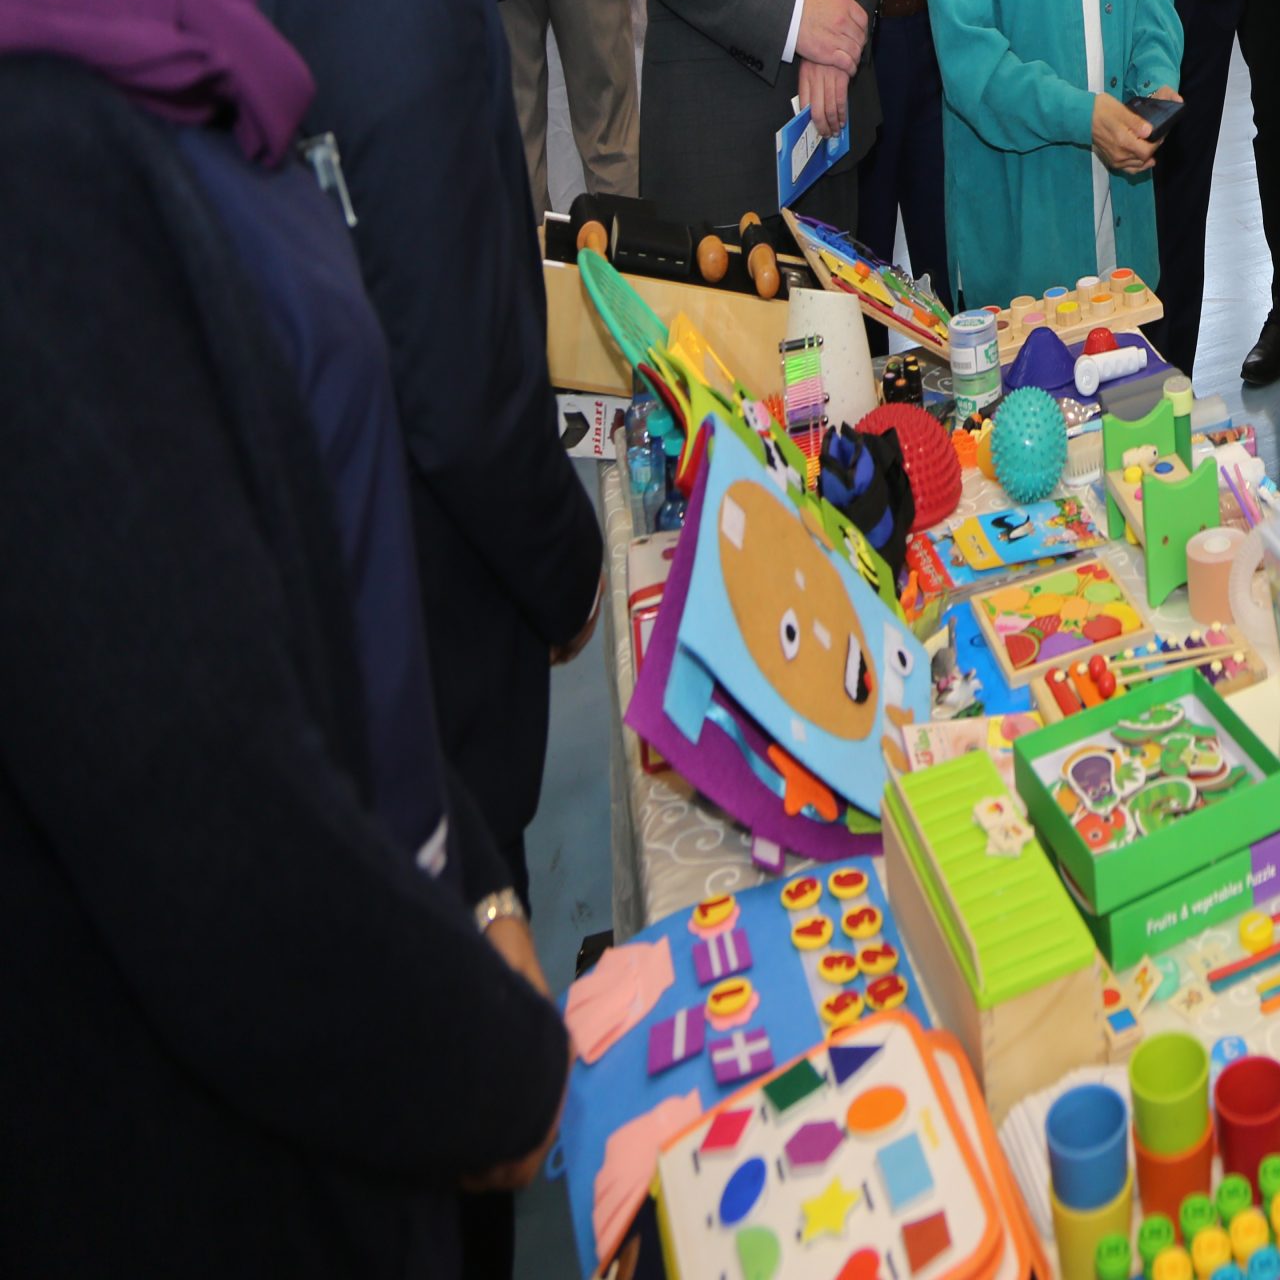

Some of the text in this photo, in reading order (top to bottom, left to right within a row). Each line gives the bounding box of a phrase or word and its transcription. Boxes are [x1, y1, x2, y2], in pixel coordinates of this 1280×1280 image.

[592, 400, 603, 457] pinart
[1146, 912, 1178, 938] Fruits
[1192, 881, 1243, 915] vegetables
[1246, 864, 1277, 888] Puzzle
